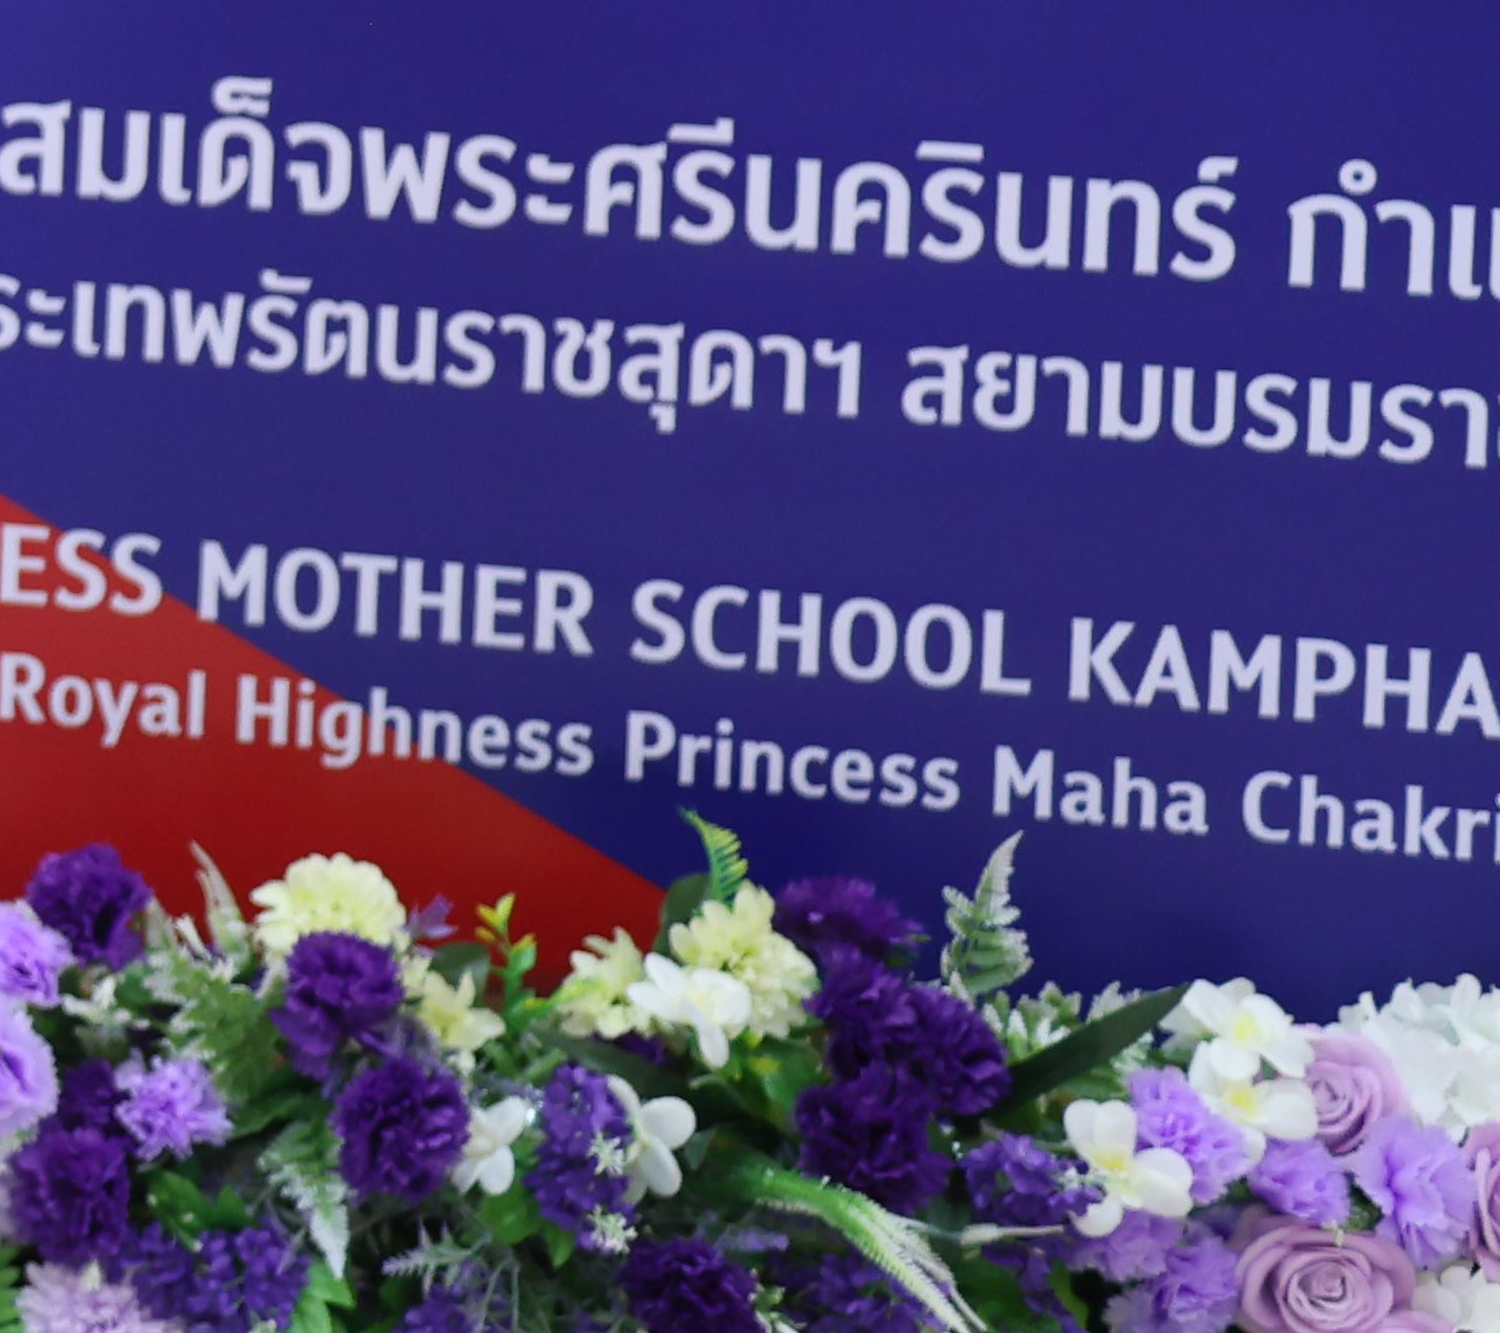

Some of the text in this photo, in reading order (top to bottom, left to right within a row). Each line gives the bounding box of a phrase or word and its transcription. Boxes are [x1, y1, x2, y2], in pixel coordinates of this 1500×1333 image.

[901, 345, 1500, 469] สยามบรมรา
[198, 540, 593, 655] MOTHER
[631, 579, 1031, 696] SCHOOL
[1068, 617, 1500, 739] KAMPHA
[237, 674, 593, 775] Highness
[626, 711, 960, 810] Princess
[993, 745, 1210, 835] Maha
